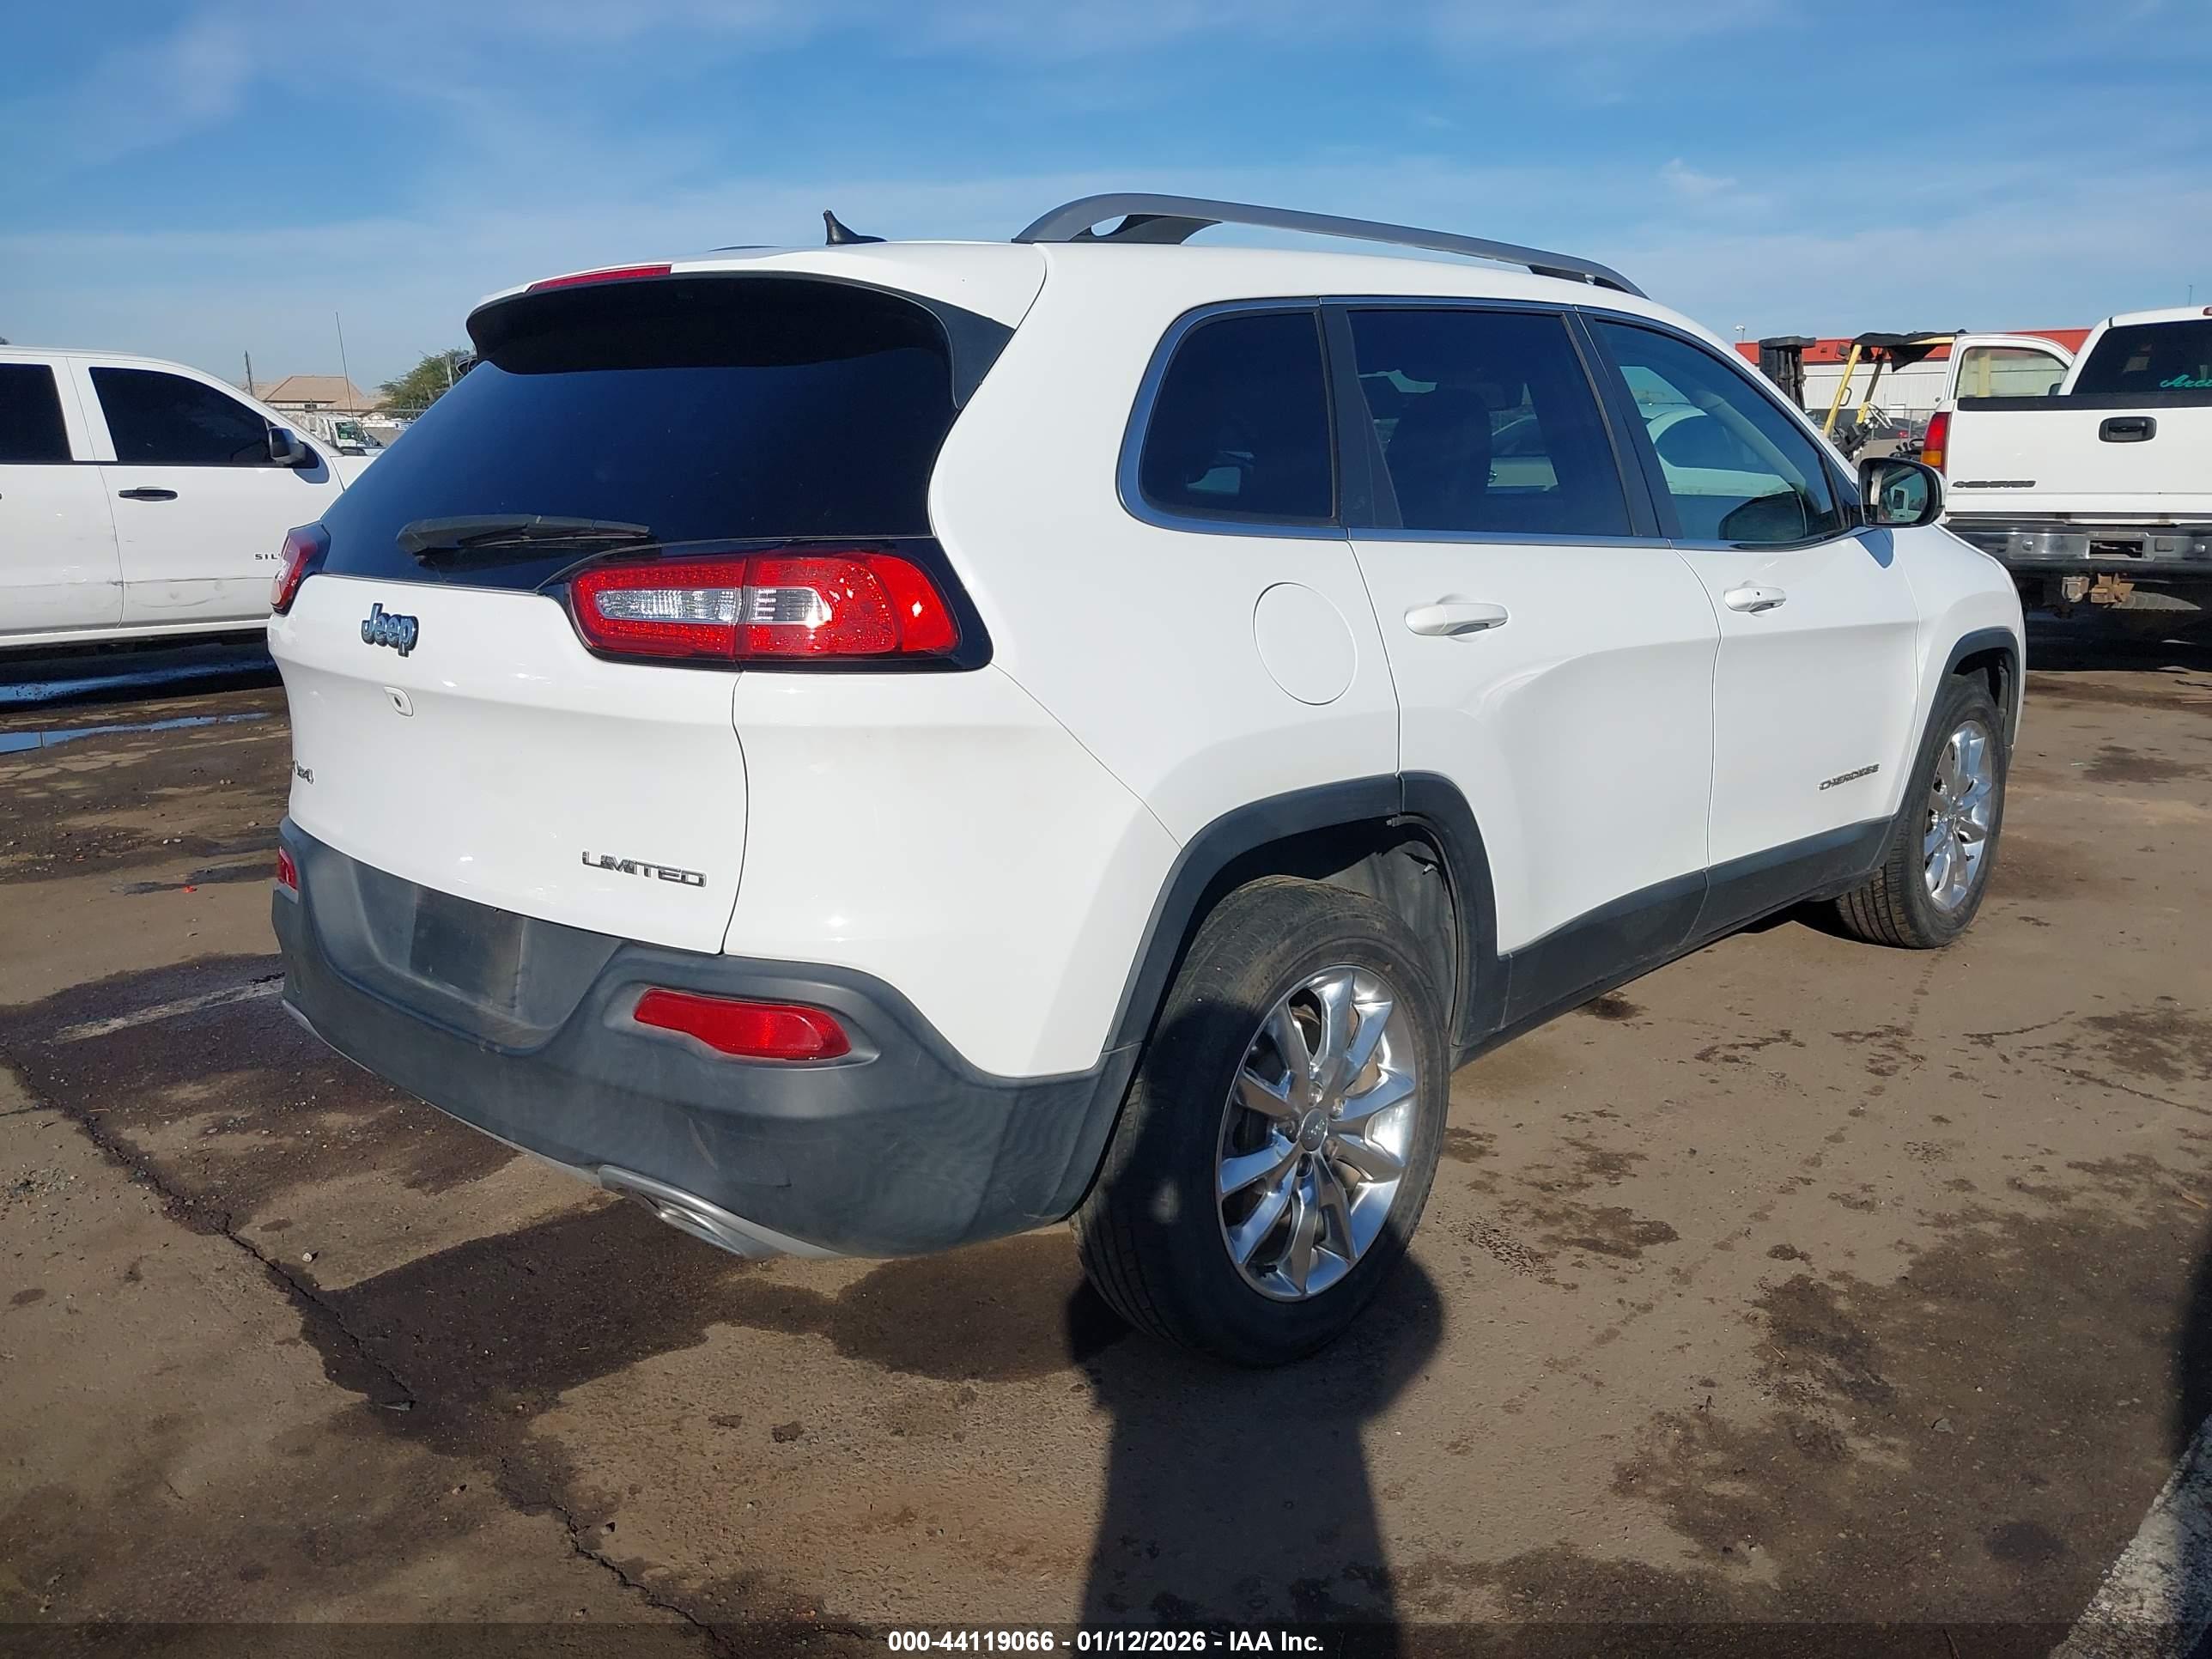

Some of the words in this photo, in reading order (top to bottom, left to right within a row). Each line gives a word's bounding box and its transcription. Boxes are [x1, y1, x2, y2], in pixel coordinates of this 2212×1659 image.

[361, 602, 419, 658] Jeep
[1819, 763, 1880, 791] CHEROKEE
[581, 850, 707, 888] LIMITED
